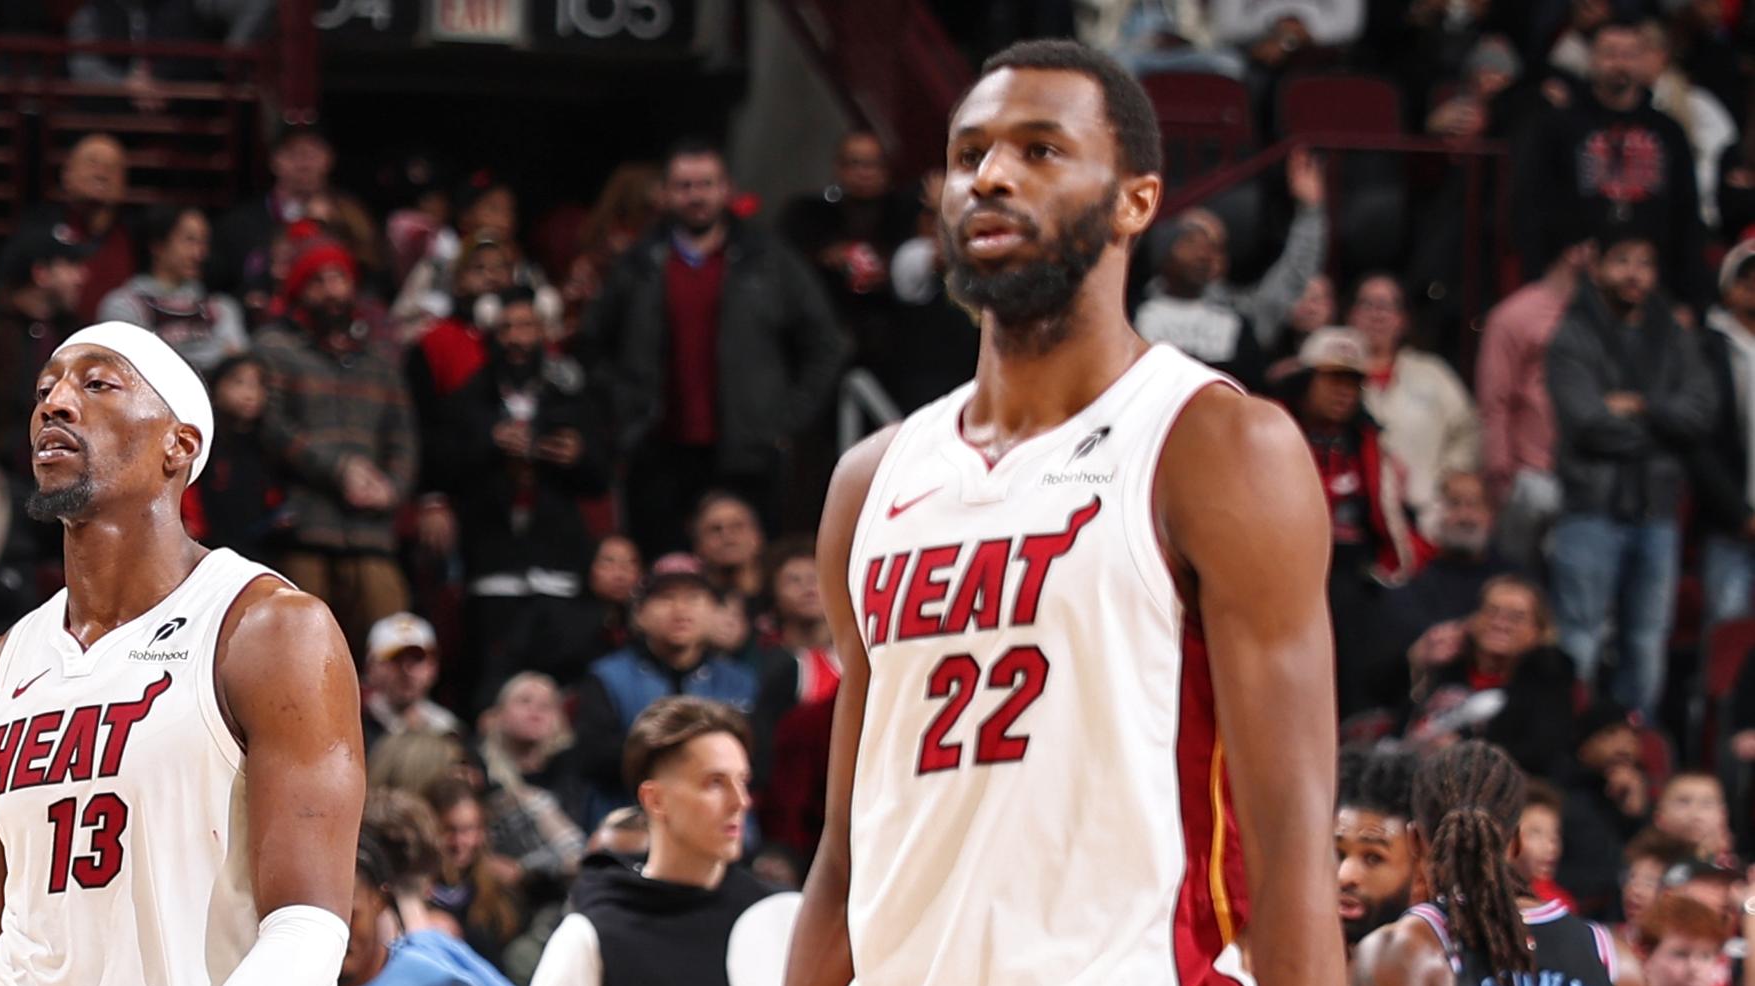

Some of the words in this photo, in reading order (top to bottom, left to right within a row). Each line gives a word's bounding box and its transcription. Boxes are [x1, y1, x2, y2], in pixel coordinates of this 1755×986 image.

[1041, 471, 1114, 486] Robinhood
[863, 494, 1101, 651] HEAT
[128, 649, 189, 662] Robinhood
[915, 645, 1050, 777] 22
[47, 792, 129, 894] 13
